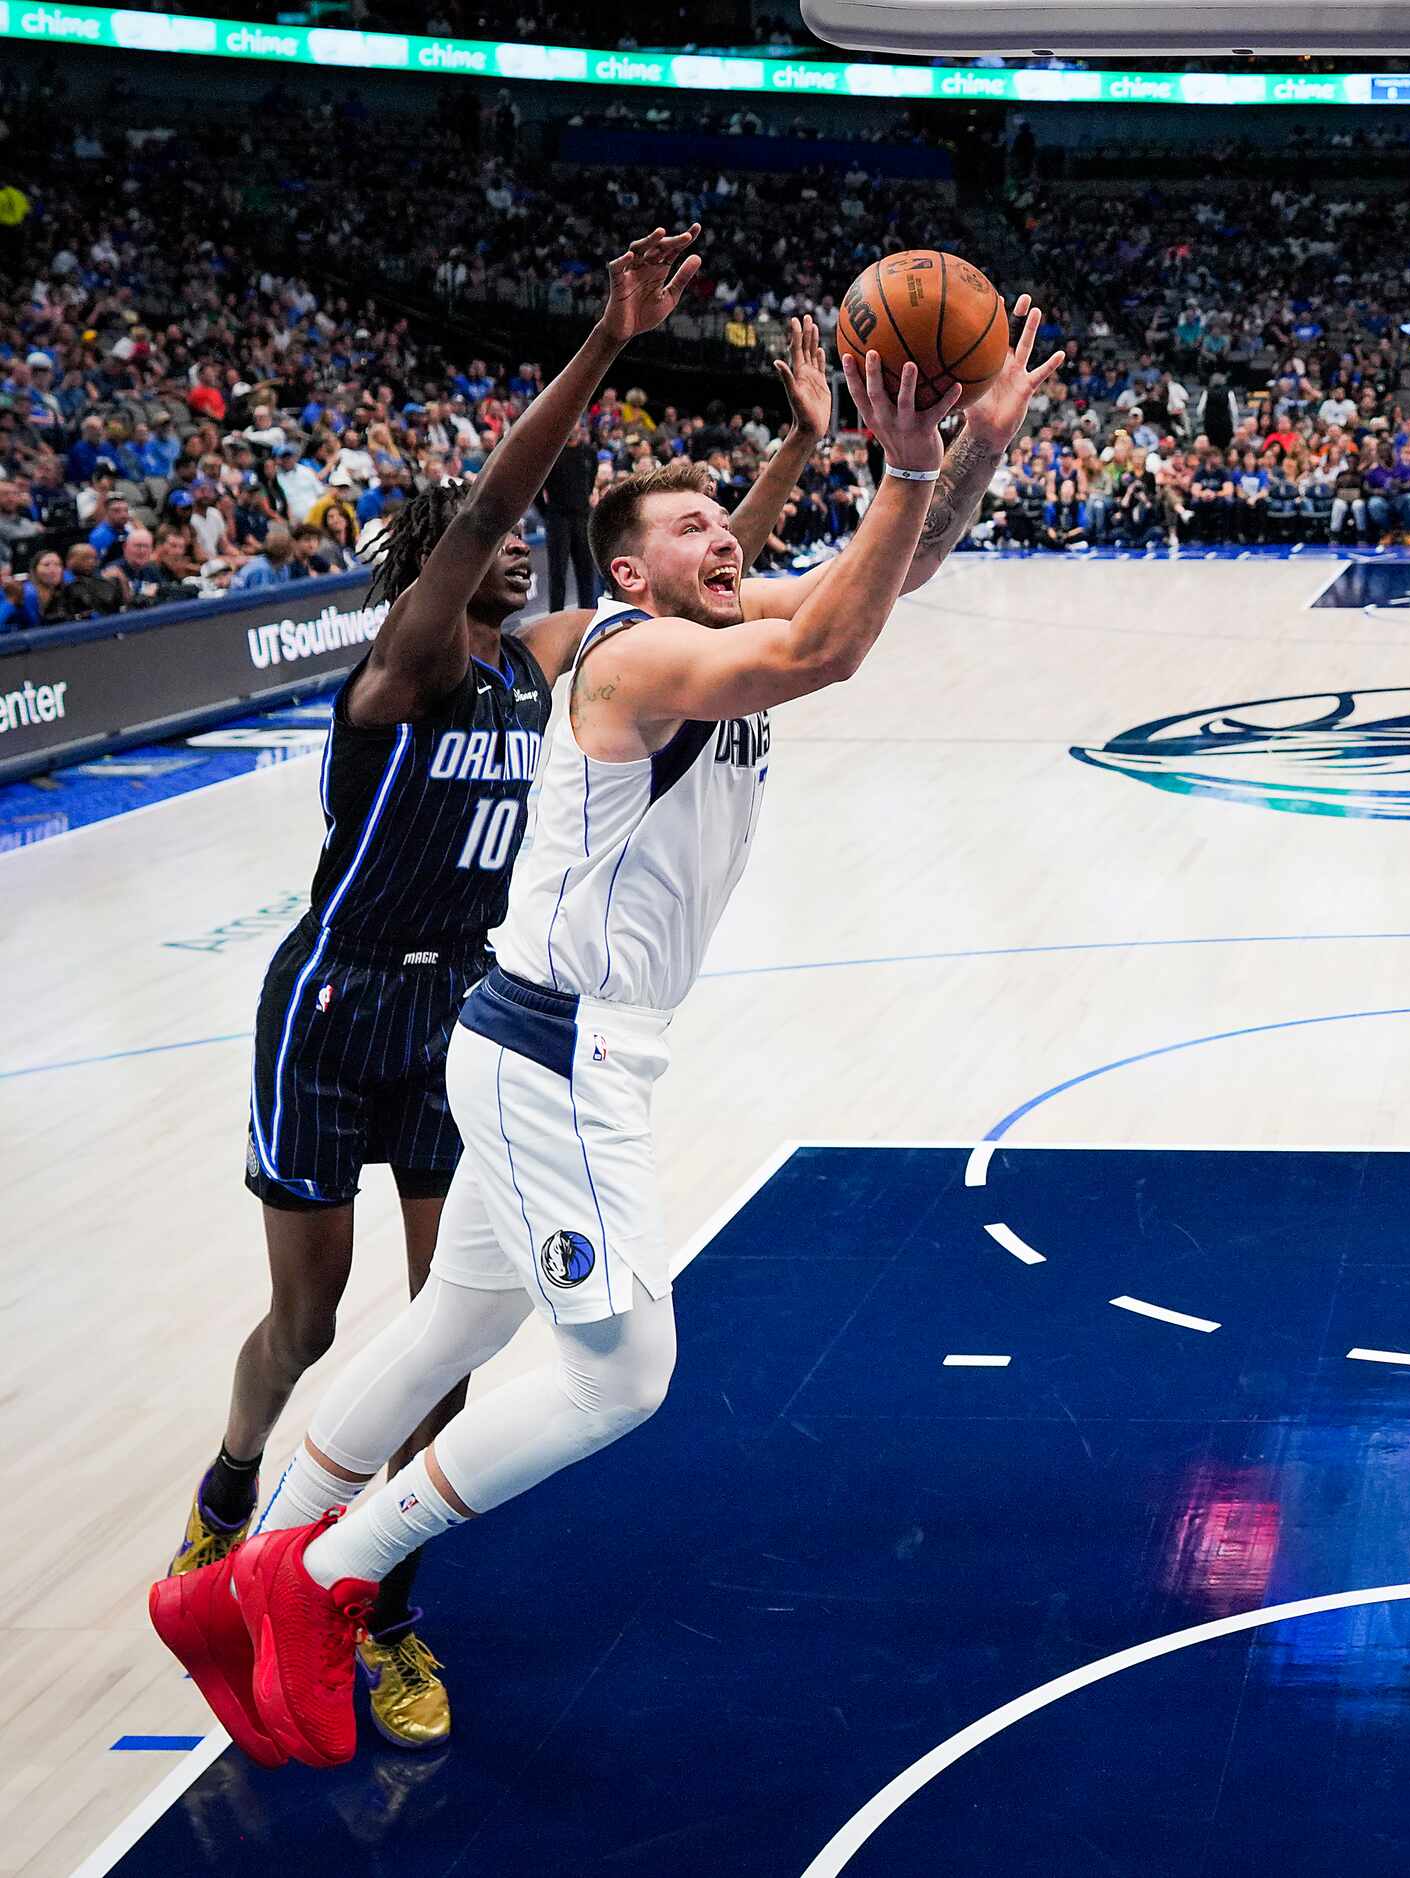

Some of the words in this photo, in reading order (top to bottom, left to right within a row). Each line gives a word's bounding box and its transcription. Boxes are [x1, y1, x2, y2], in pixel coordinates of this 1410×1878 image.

[21, 8, 100, 39] chime
[226, 27, 298, 56] chime
[419, 43, 486, 70] chime
[596, 55, 662, 82] chime
[773, 65, 837, 89] chime
[942, 72, 1005, 95] chime
[1110, 76, 1172, 99] chime
[1274, 77, 1335, 99] chime
[457, 799, 520, 870] 10
[402, 951, 439, 966] MAGIC
